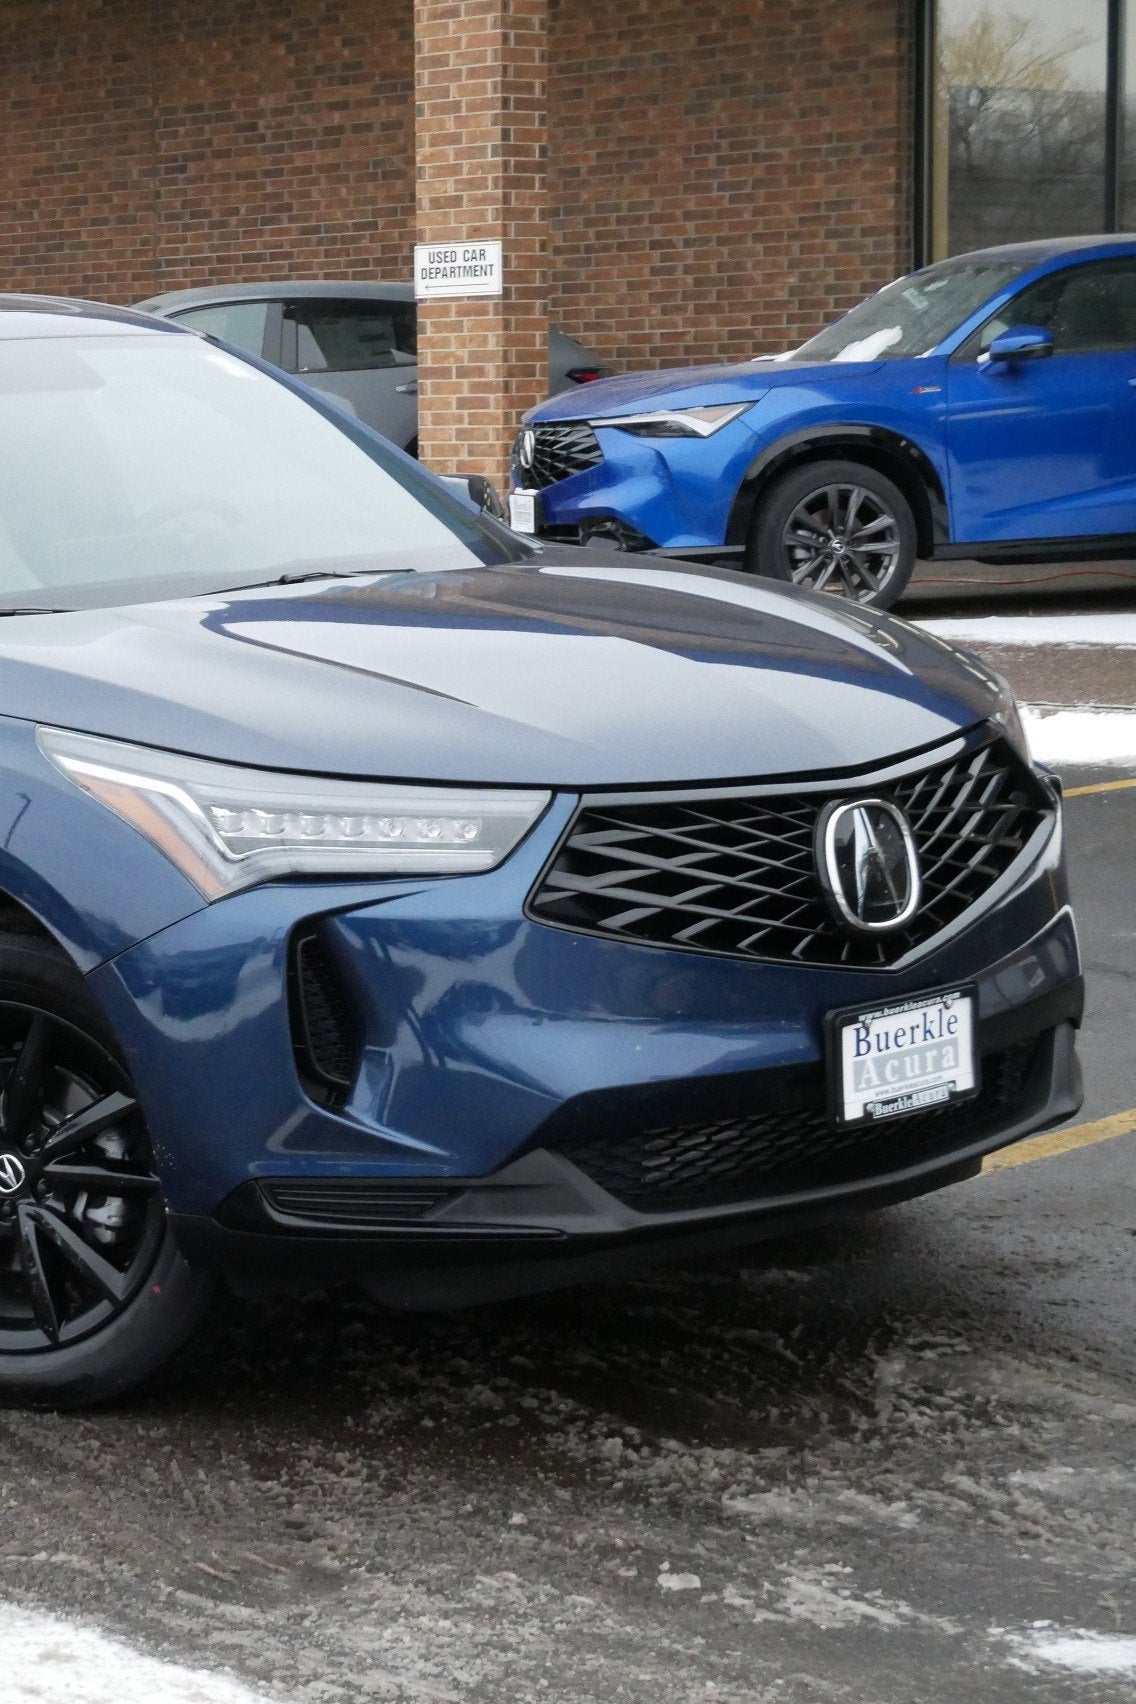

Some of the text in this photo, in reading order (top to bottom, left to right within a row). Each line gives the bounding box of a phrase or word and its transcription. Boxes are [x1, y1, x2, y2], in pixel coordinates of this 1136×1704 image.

[428, 248, 486, 264] USED CAR
[421, 264, 494, 280] DEPARTMENT
[853, 1008, 958, 1057] Buerkle
[858, 1045, 956, 1089] Acura
